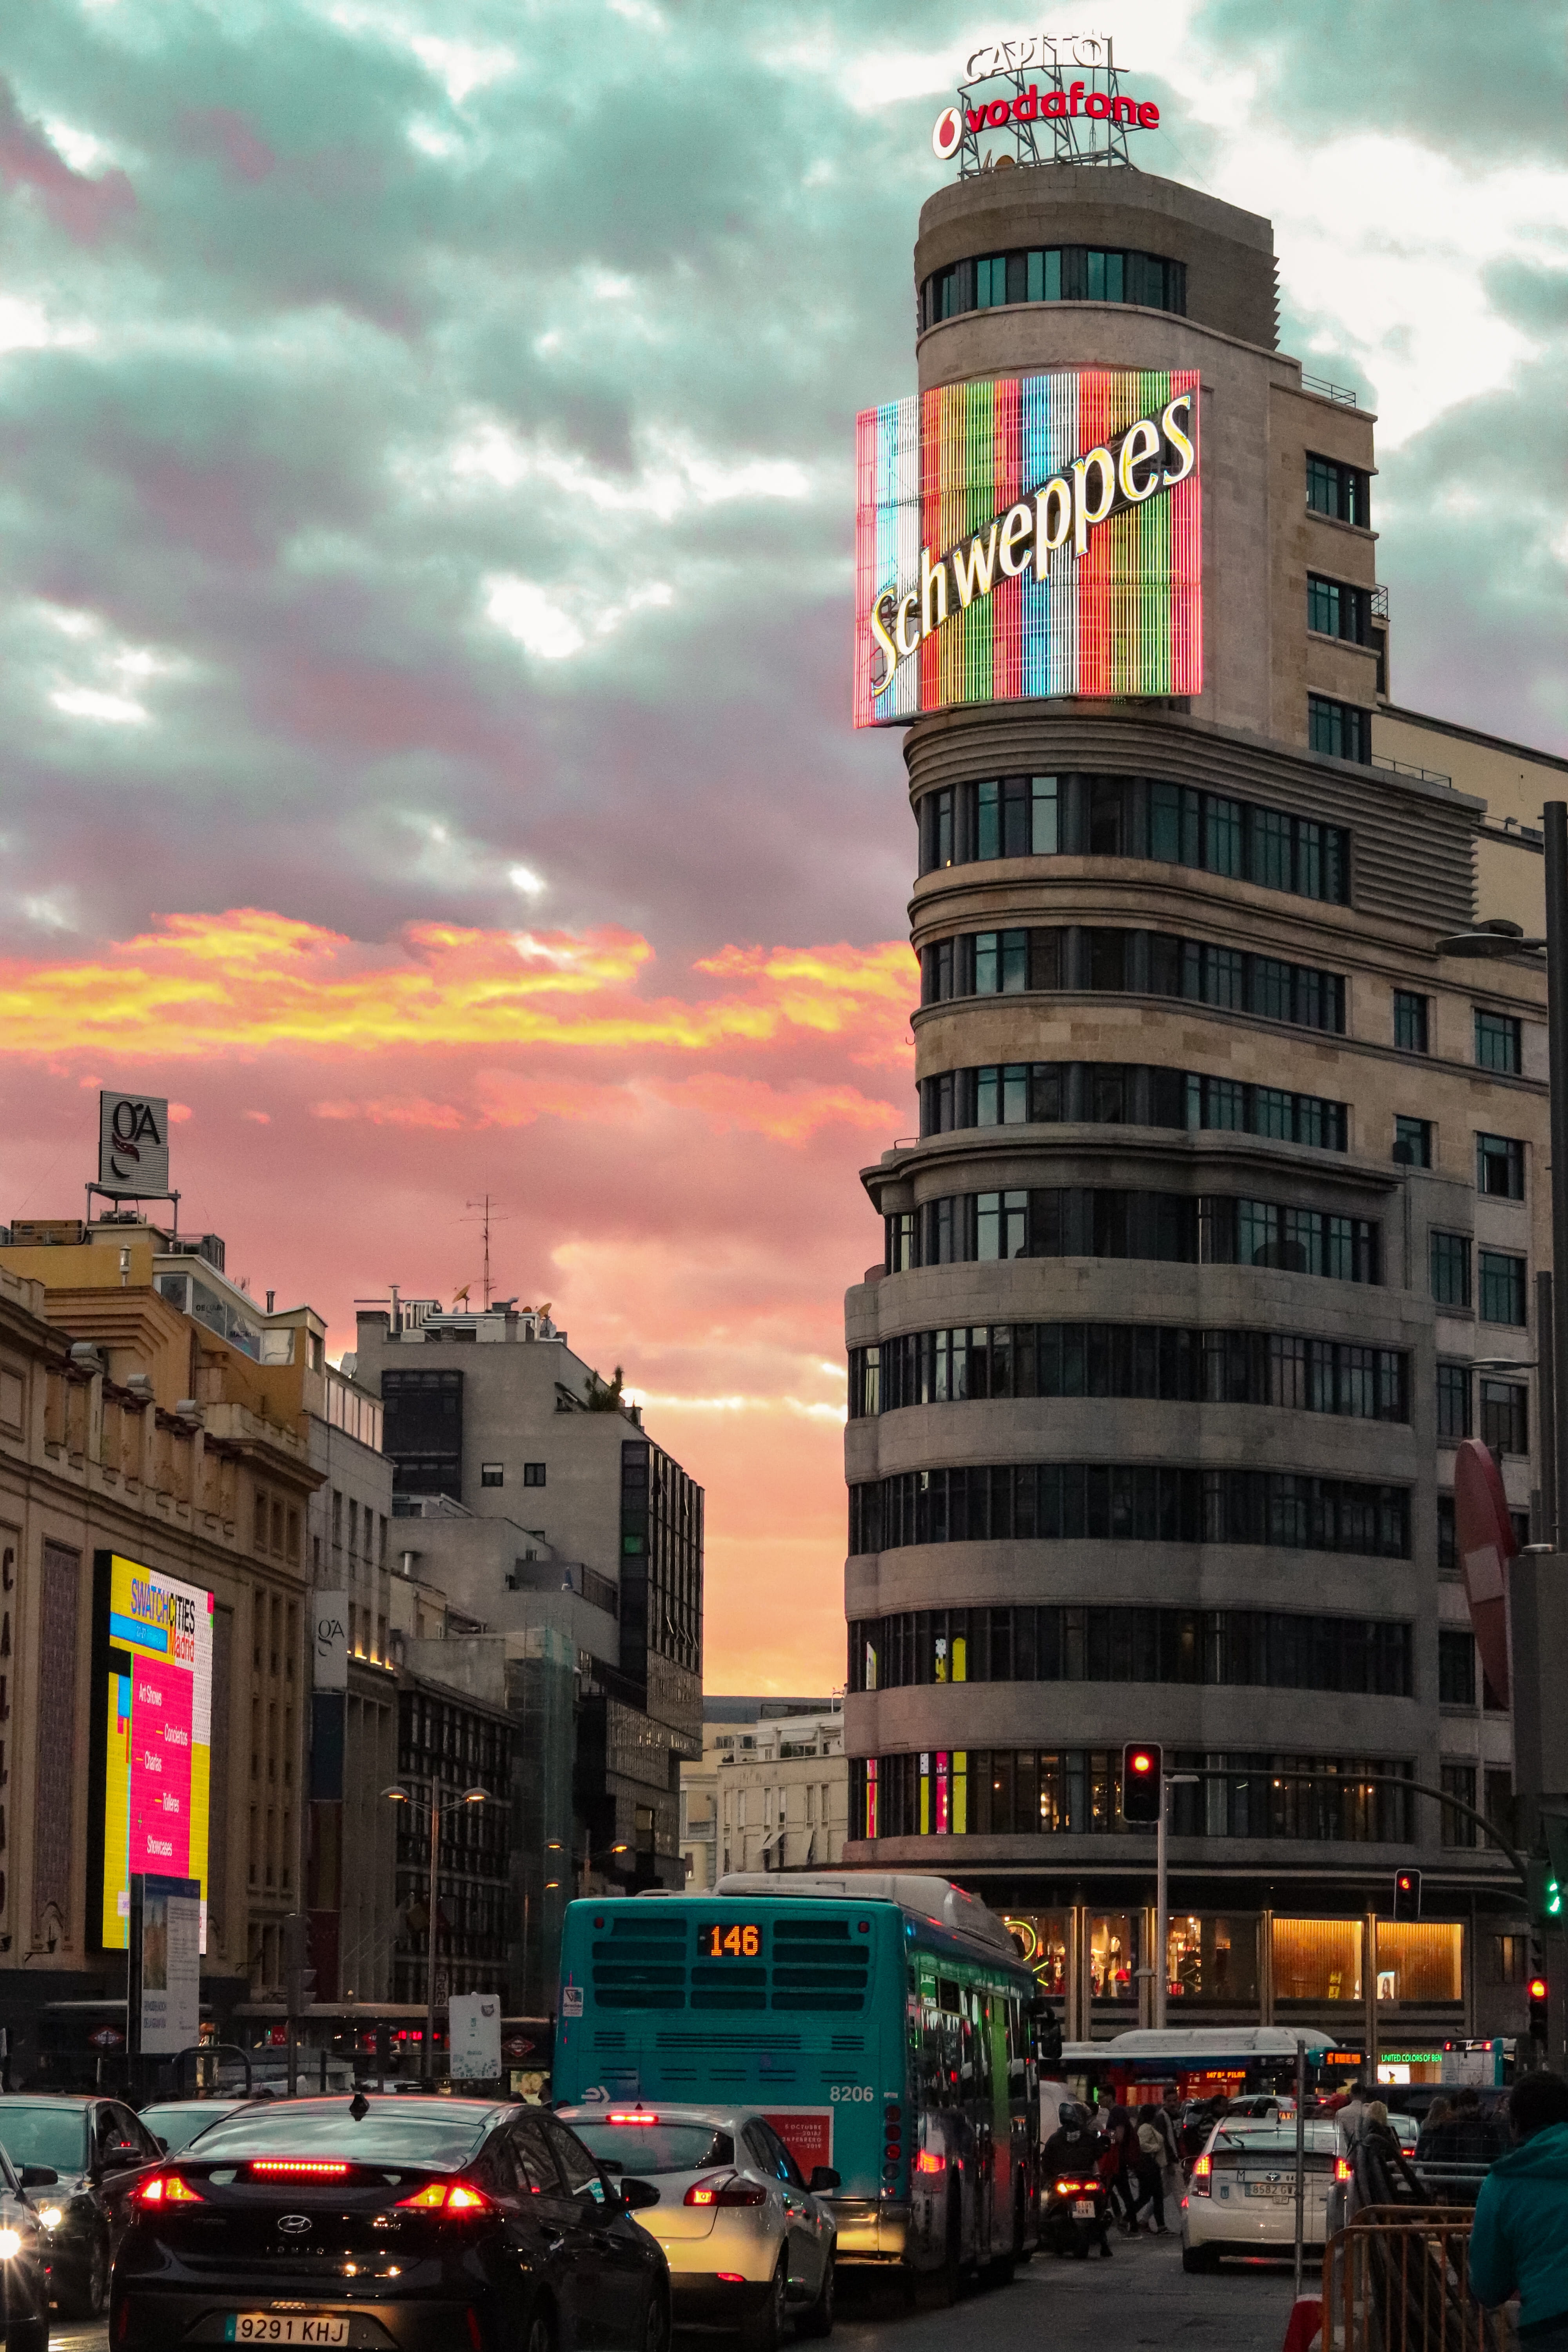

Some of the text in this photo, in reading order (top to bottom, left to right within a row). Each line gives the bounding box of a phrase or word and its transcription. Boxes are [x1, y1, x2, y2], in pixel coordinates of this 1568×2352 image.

[966, 81, 1160, 133] vodafone
[870, 394, 1194, 696] Schweppes
[147, 1685, 162, 1707] Shows
[165, 1723, 188, 1746] Conciertos
[145, 1751, 162, 1772] Charlas
[163, 1792, 180, 1813] Talleres
[147, 1835, 172, 1857] Showcases
[711, 1926, 758, 1956] 146
[829, 2086, 874, 2102] 8206
[1237, 2171, 1245, 2181] M
[1253, 2185, 1277, 2194] 8582
[241, 2319, 343, 2342] 9291 KHJ
